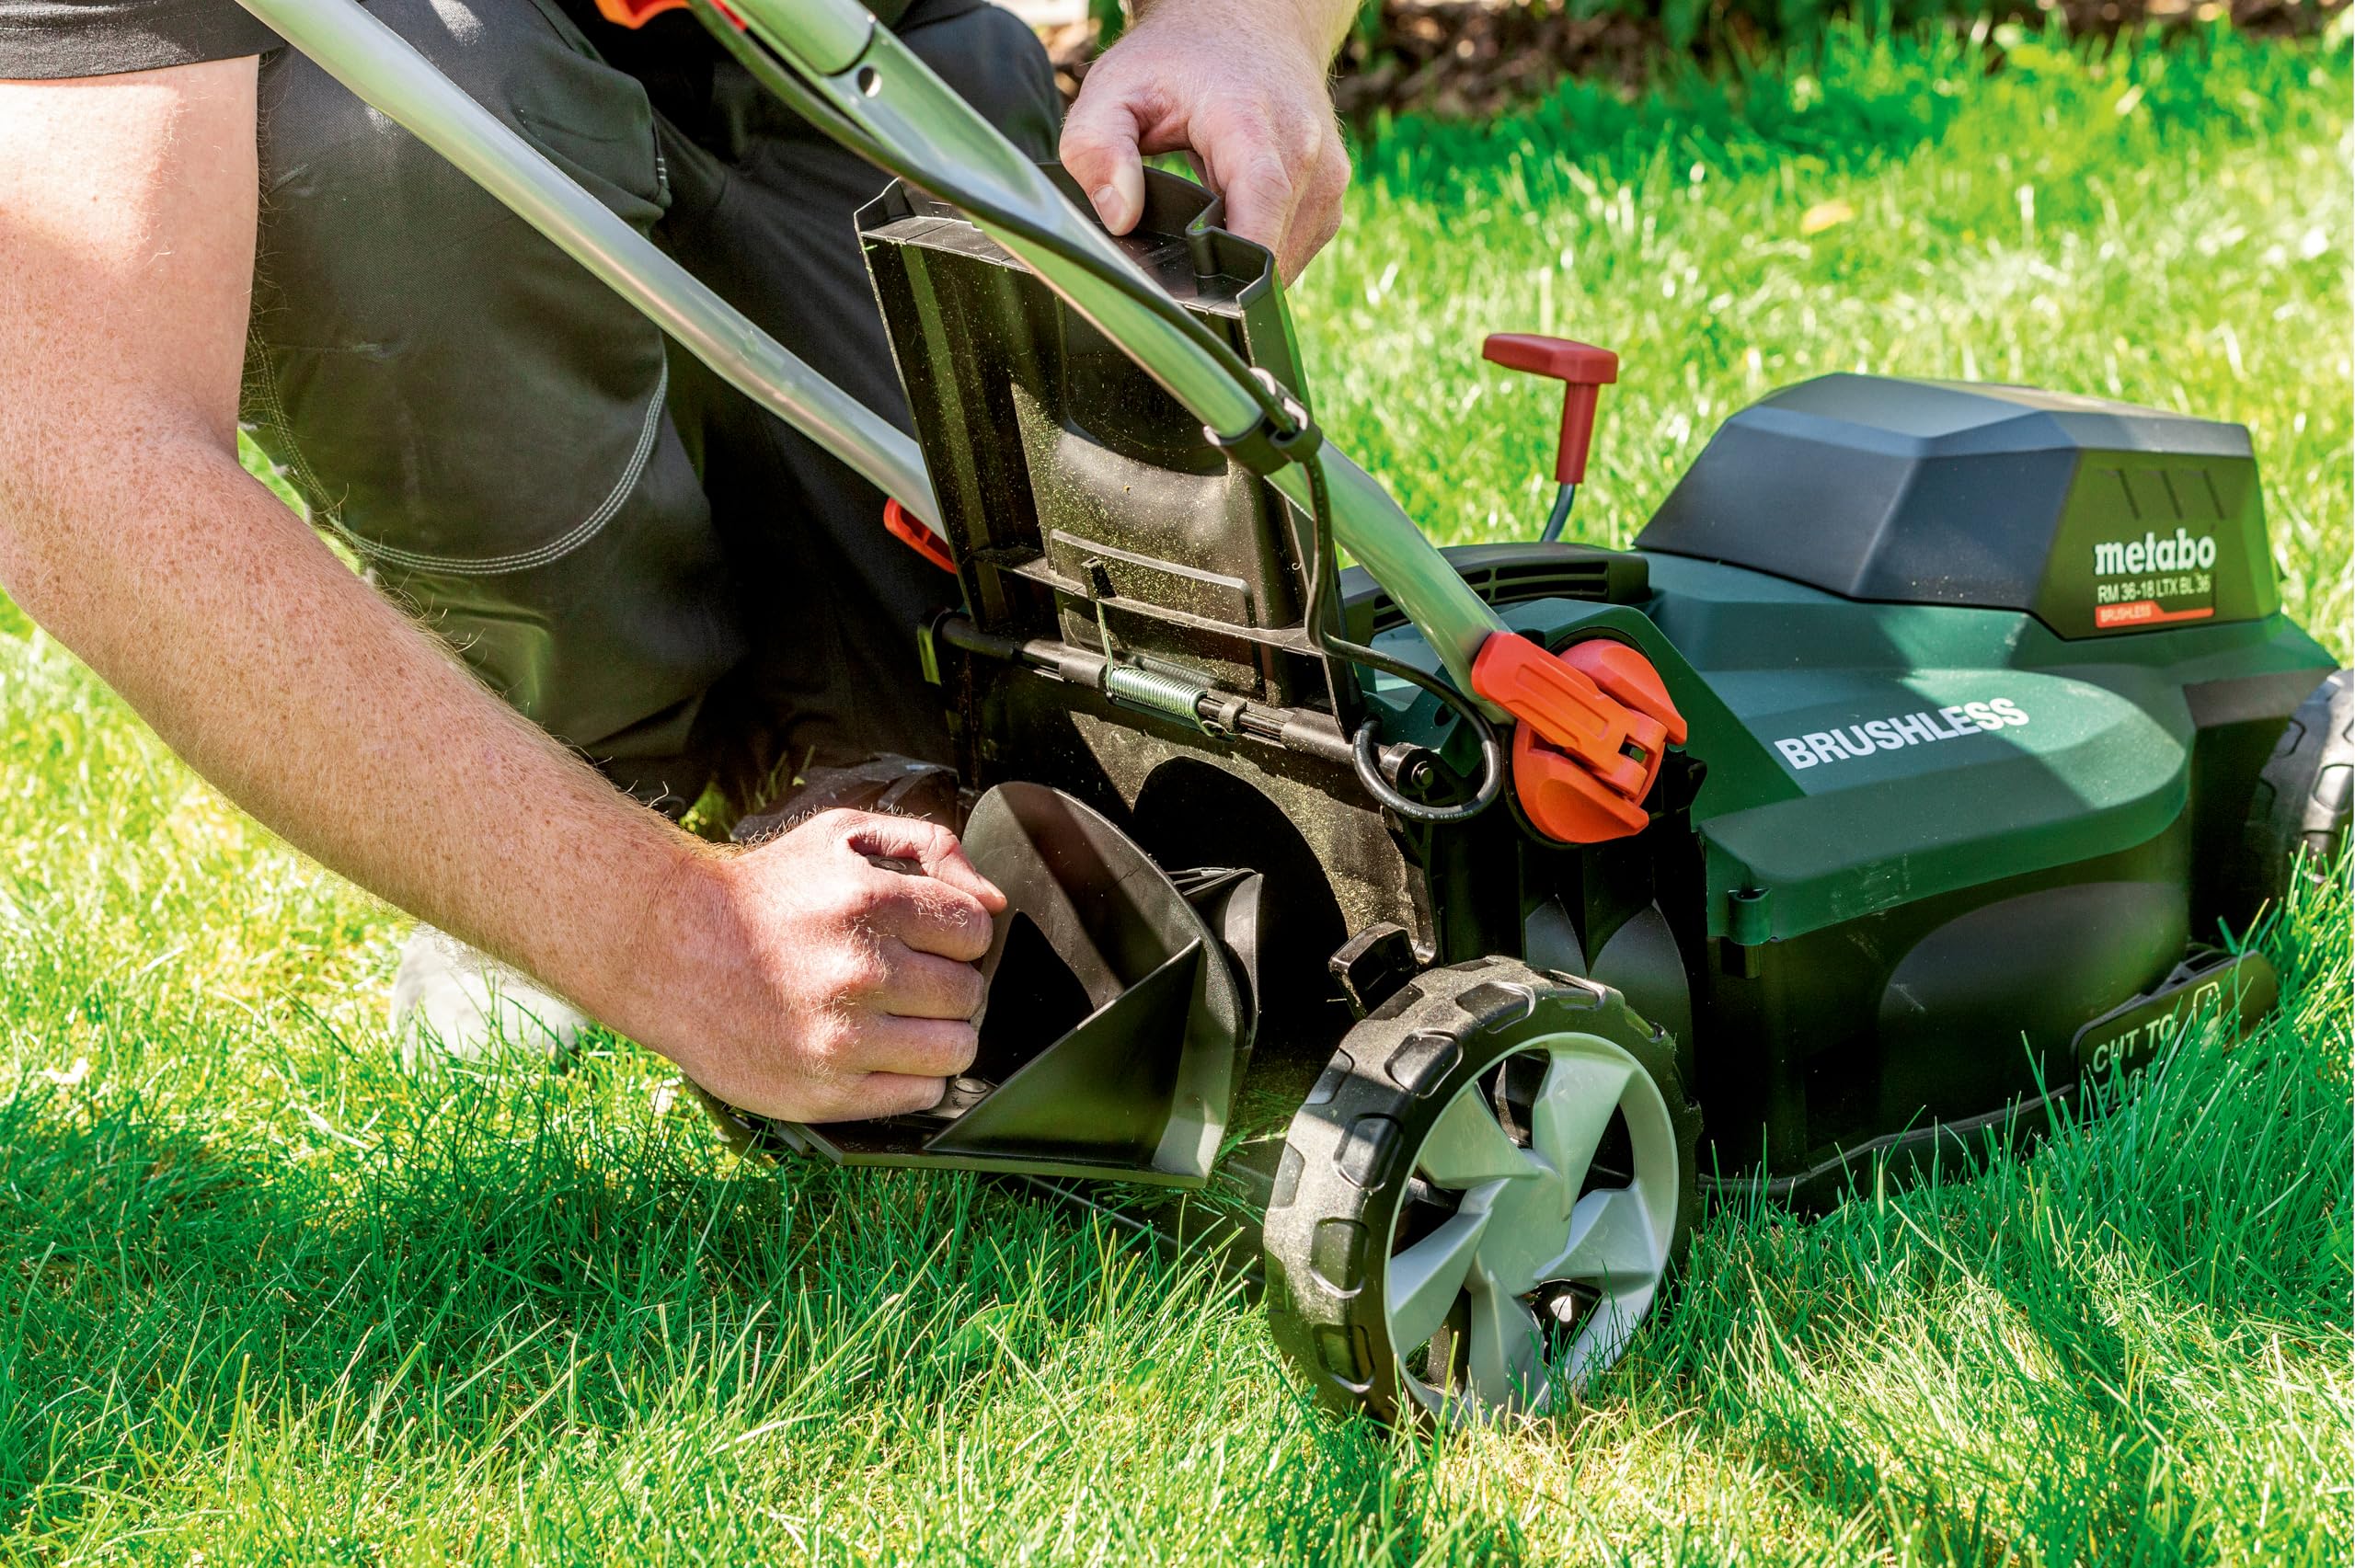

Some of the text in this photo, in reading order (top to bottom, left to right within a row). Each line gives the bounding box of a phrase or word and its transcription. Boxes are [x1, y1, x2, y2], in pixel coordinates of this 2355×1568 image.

[2095, 528, 2217, 576] metabo
[2097, 572, 2211, 603] RM 36-18 LTX BL 36
[1774, 697, 2030, 770] BRUSHLESS
[2093, 1013, 2176, 1073] CUT TO
